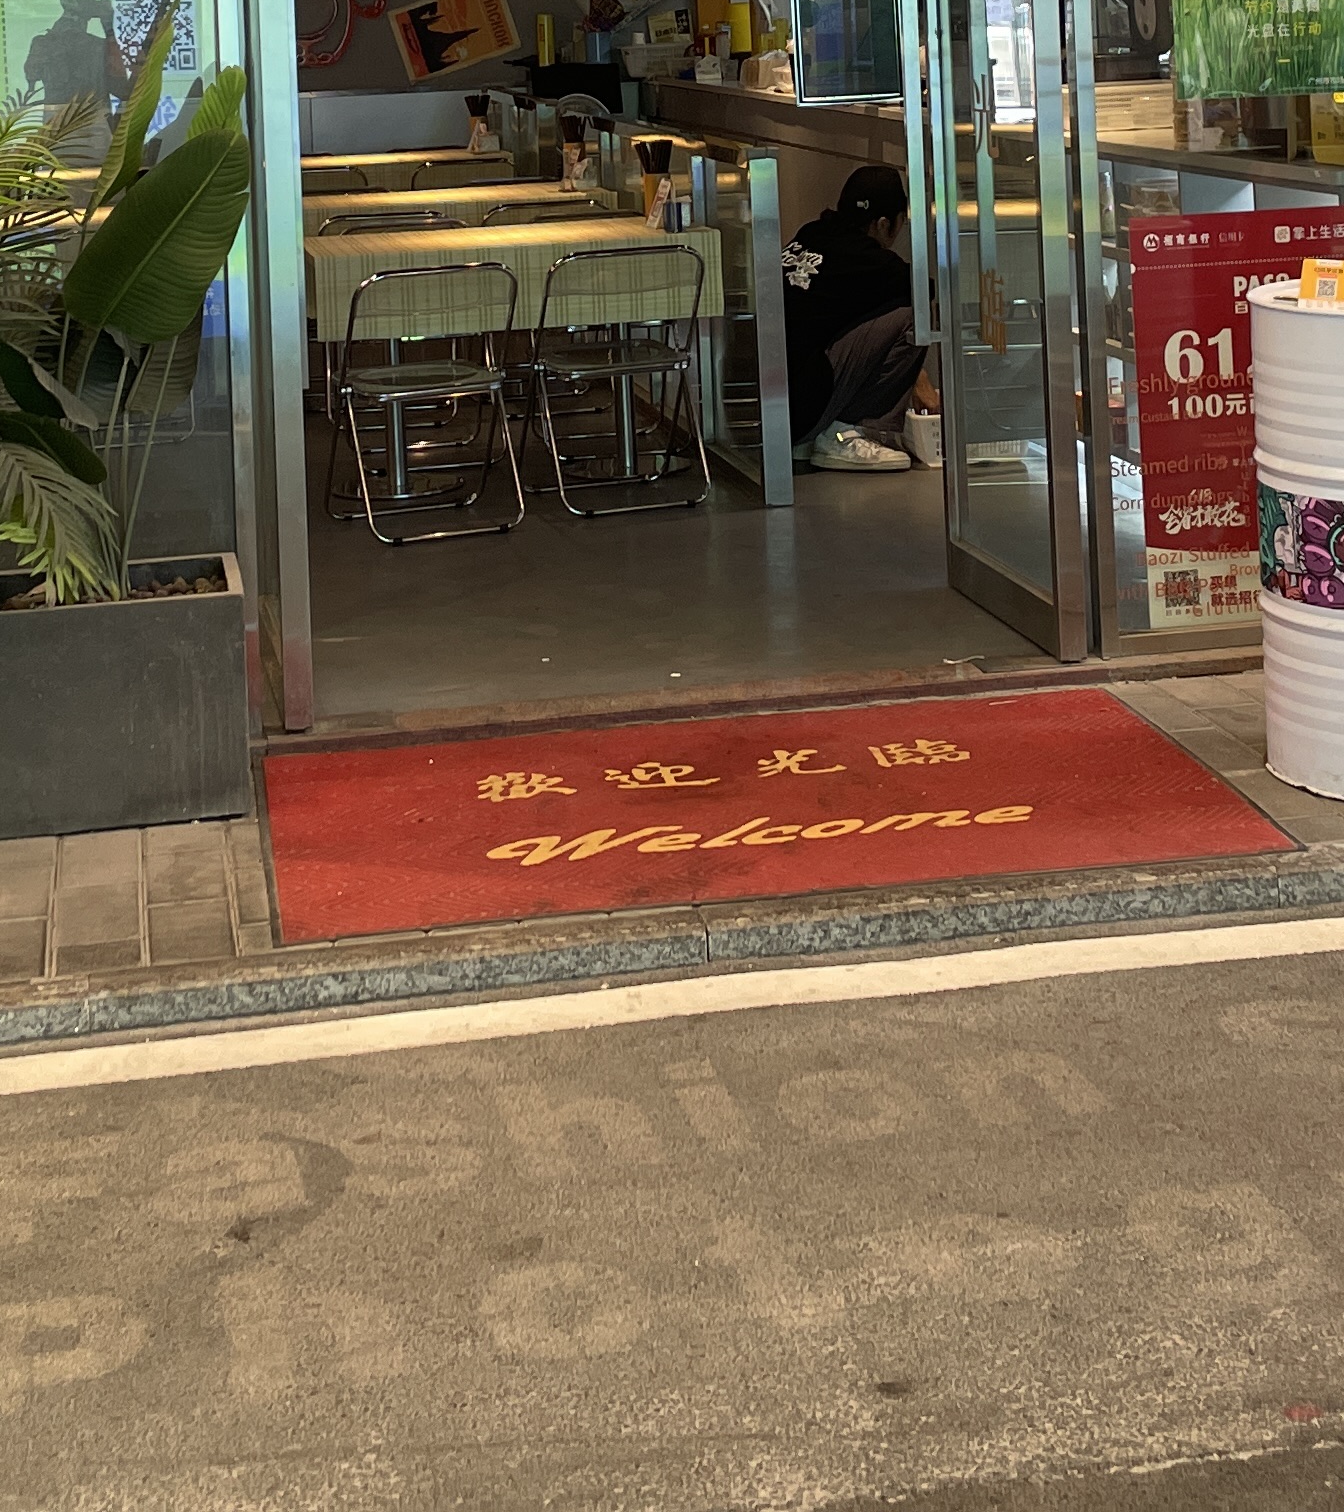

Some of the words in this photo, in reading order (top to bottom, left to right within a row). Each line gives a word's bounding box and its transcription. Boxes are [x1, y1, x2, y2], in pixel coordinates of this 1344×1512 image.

[1246, 22, 1323, 39] 光盘在行动
[1110, 453, 1190, 477] Steamed
[1188, 541, 1251, 562] Stuffed
[485, 803, 1034, 868] Welcome
